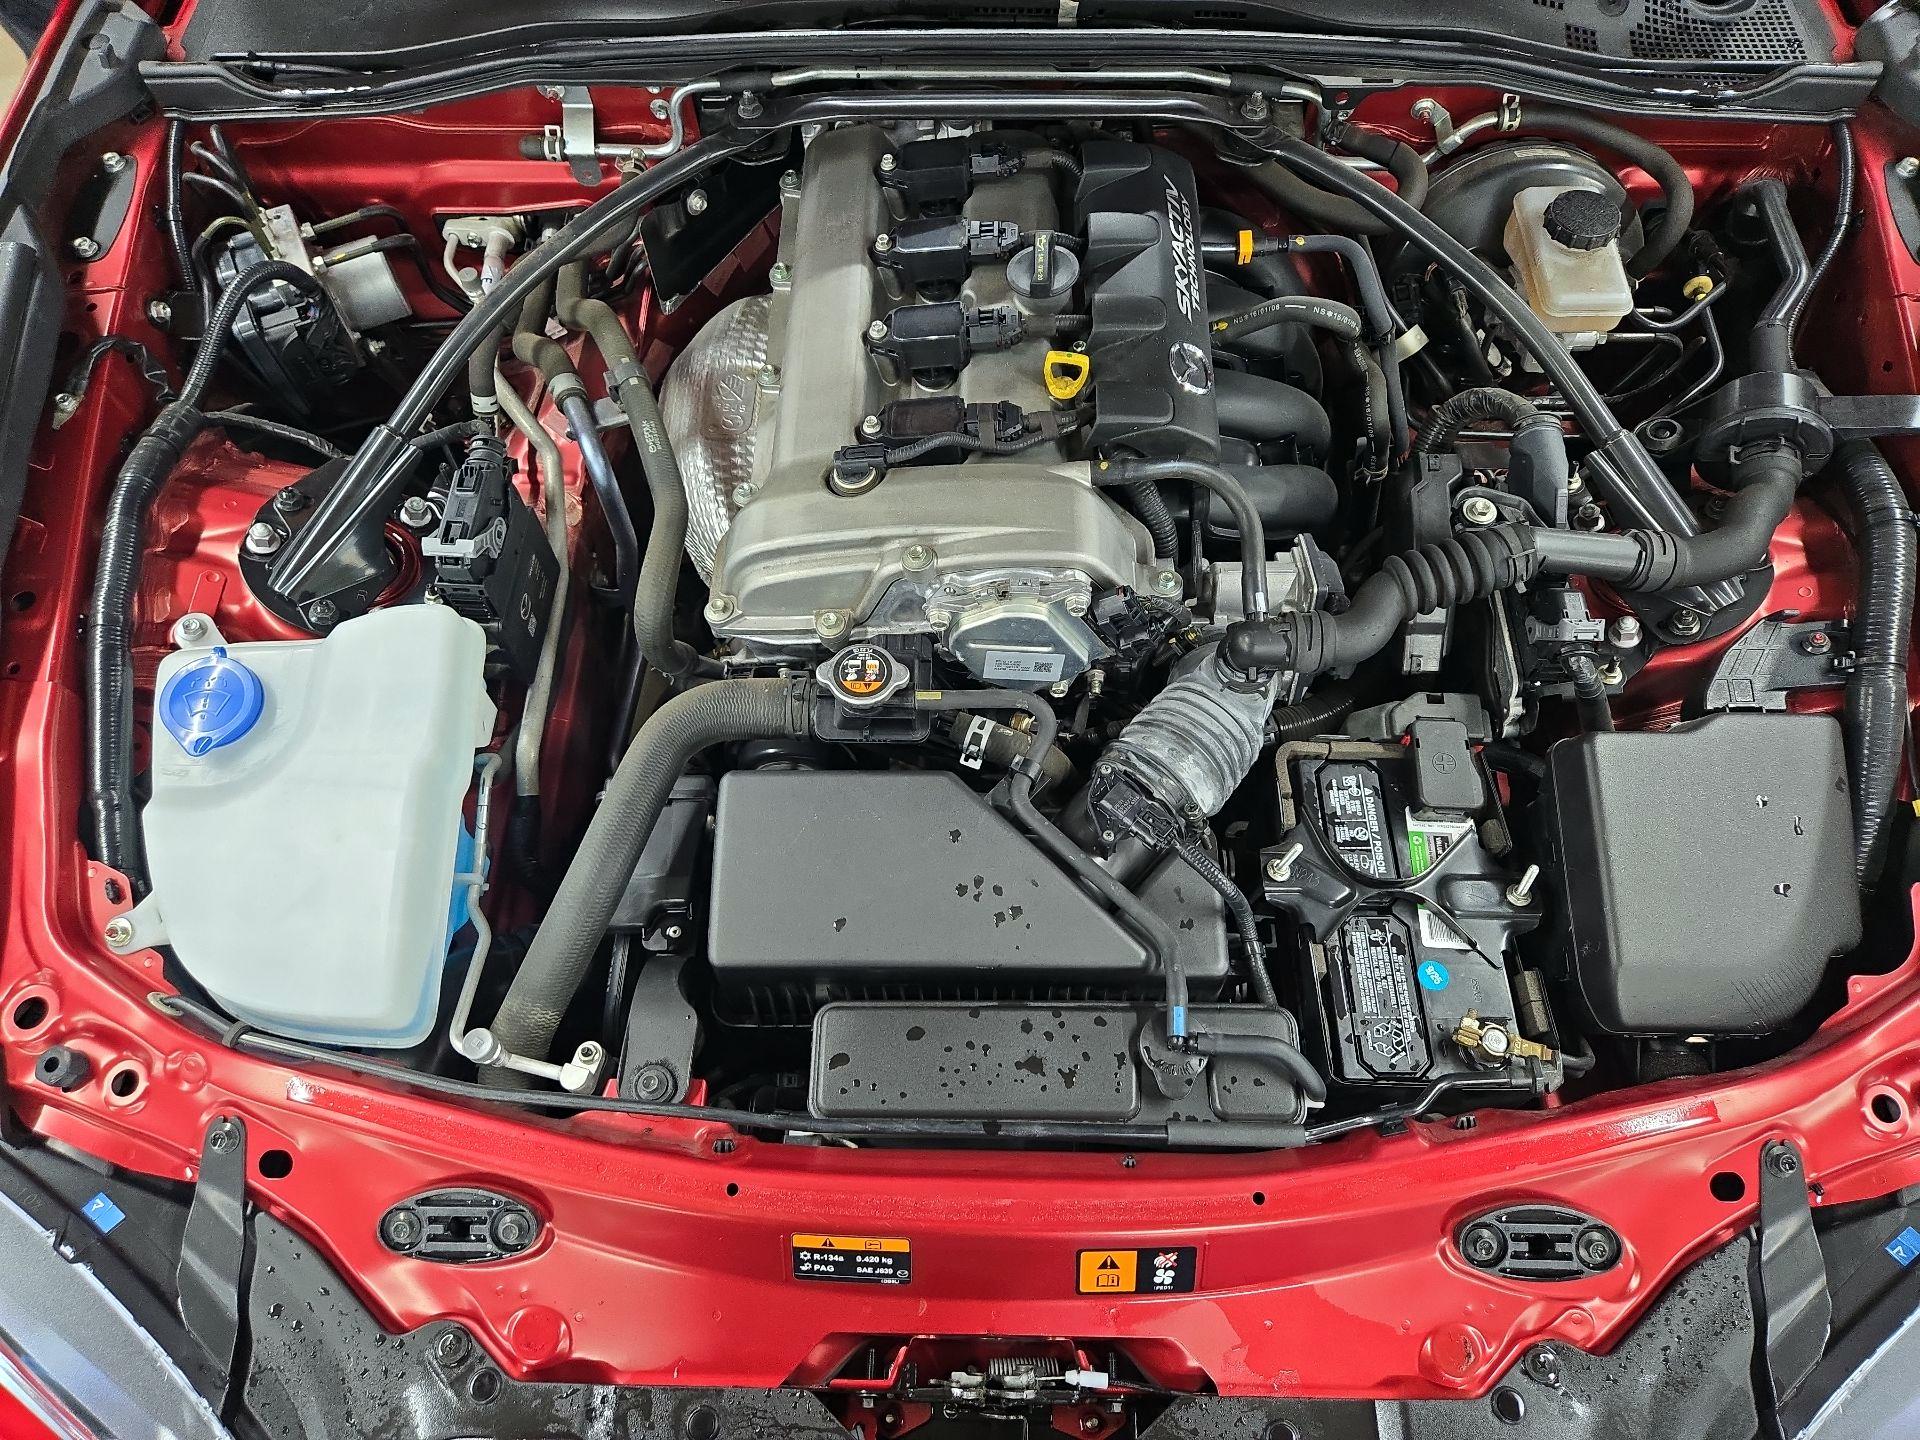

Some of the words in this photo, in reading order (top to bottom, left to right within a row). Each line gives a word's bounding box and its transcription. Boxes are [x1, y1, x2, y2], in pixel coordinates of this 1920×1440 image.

[1163, 173, 1193, 323] SKYACTIV
[1179, 191, 1201, 312] TECHNOLOGY
[1365, 797, 1379, 831] DANGER
[1373, 841, 1386, 873] POISON
[813, 1253, 844, 1262] R-134a
[856, 1255, 879, 1264] 0.420
[881, 1256, 893, 1265] kg
[813, 1264, 835, 1272] PAG
[856, 1266, 873, 1274] SAE
